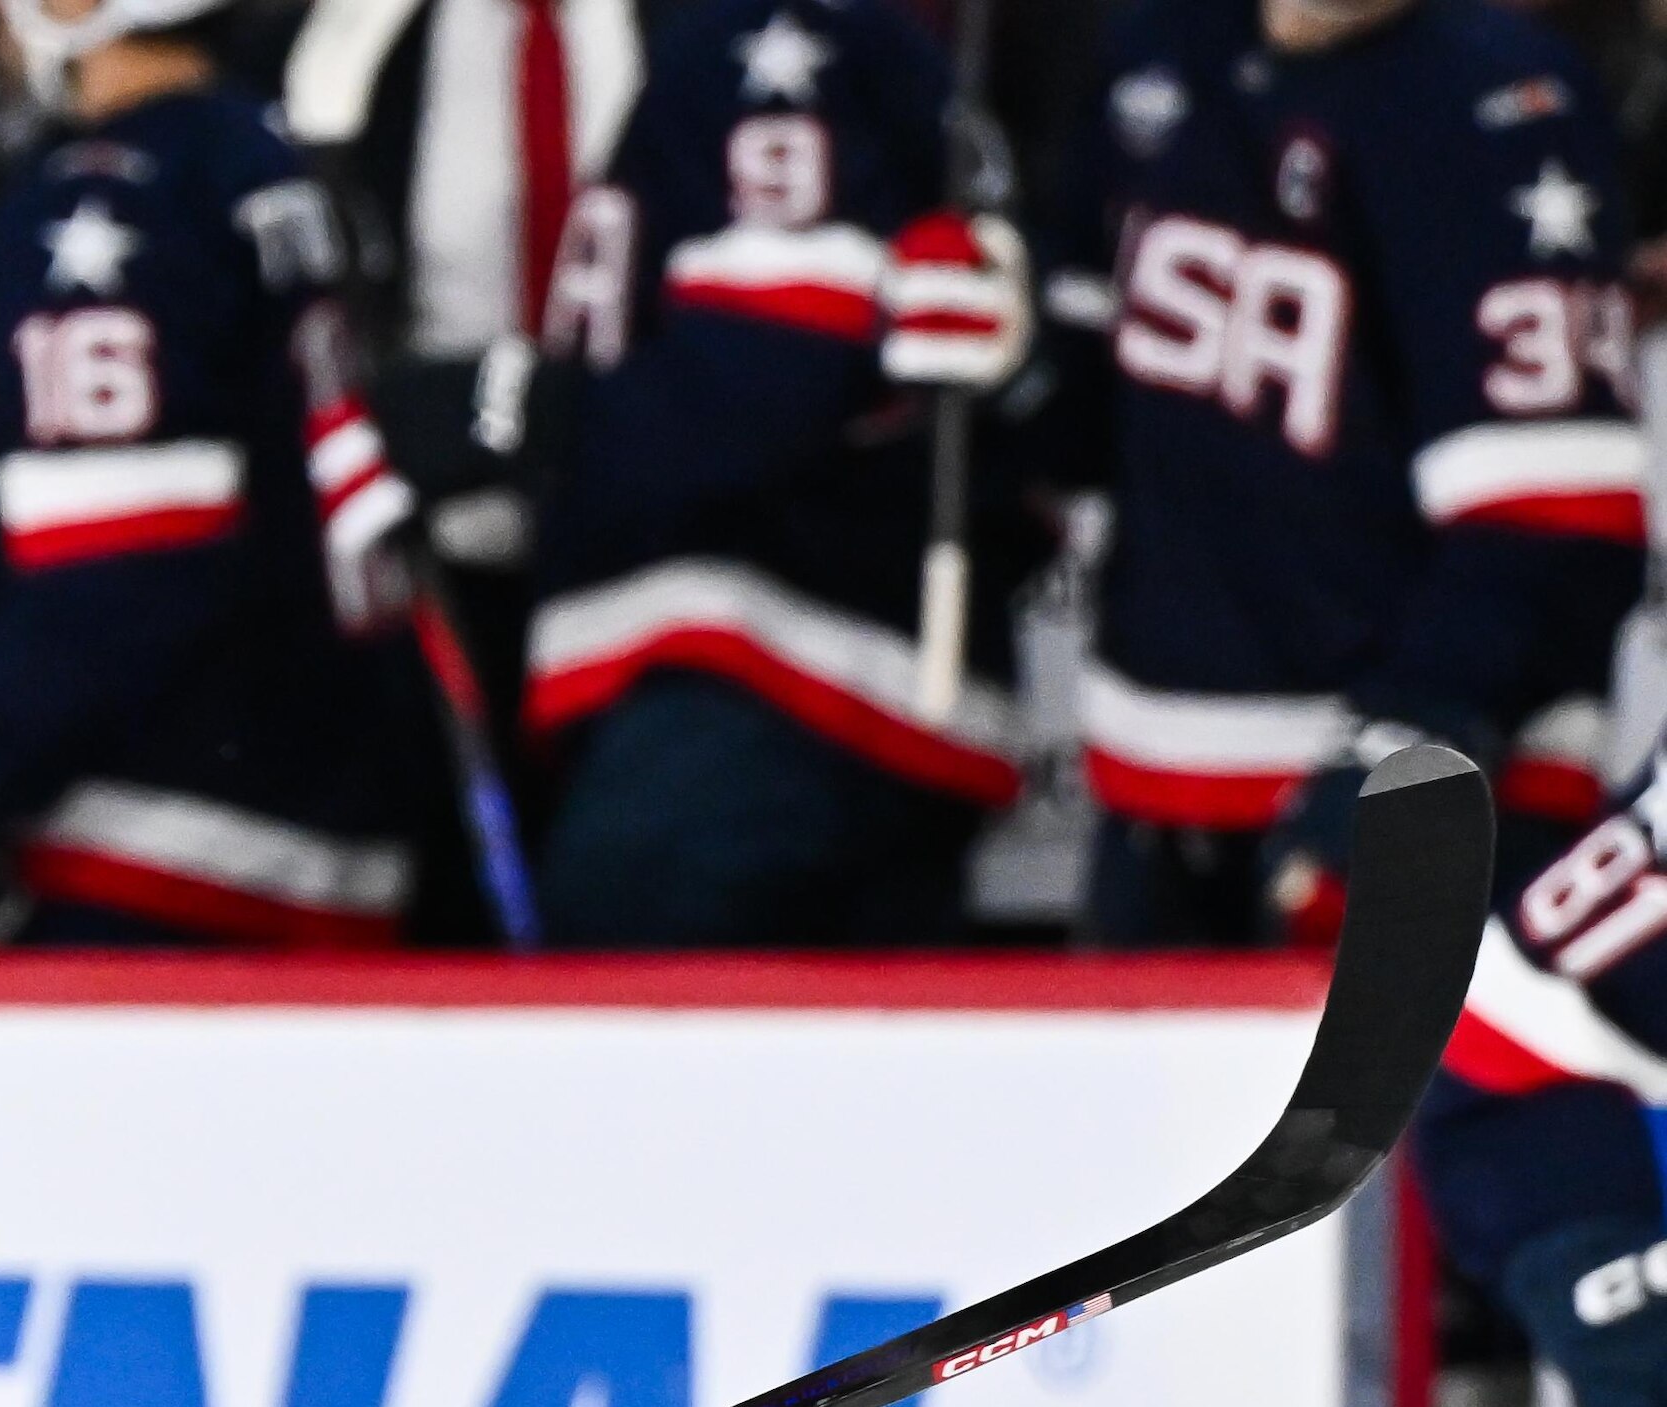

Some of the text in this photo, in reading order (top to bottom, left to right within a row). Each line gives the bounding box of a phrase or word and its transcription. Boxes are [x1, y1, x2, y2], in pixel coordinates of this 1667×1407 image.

[727, 112, 831, 226] 9
[13, 306, 157, 444] 16
[1113, 208, 1351, 458] SA
[941, 1316, 1059, 1378] CCM
